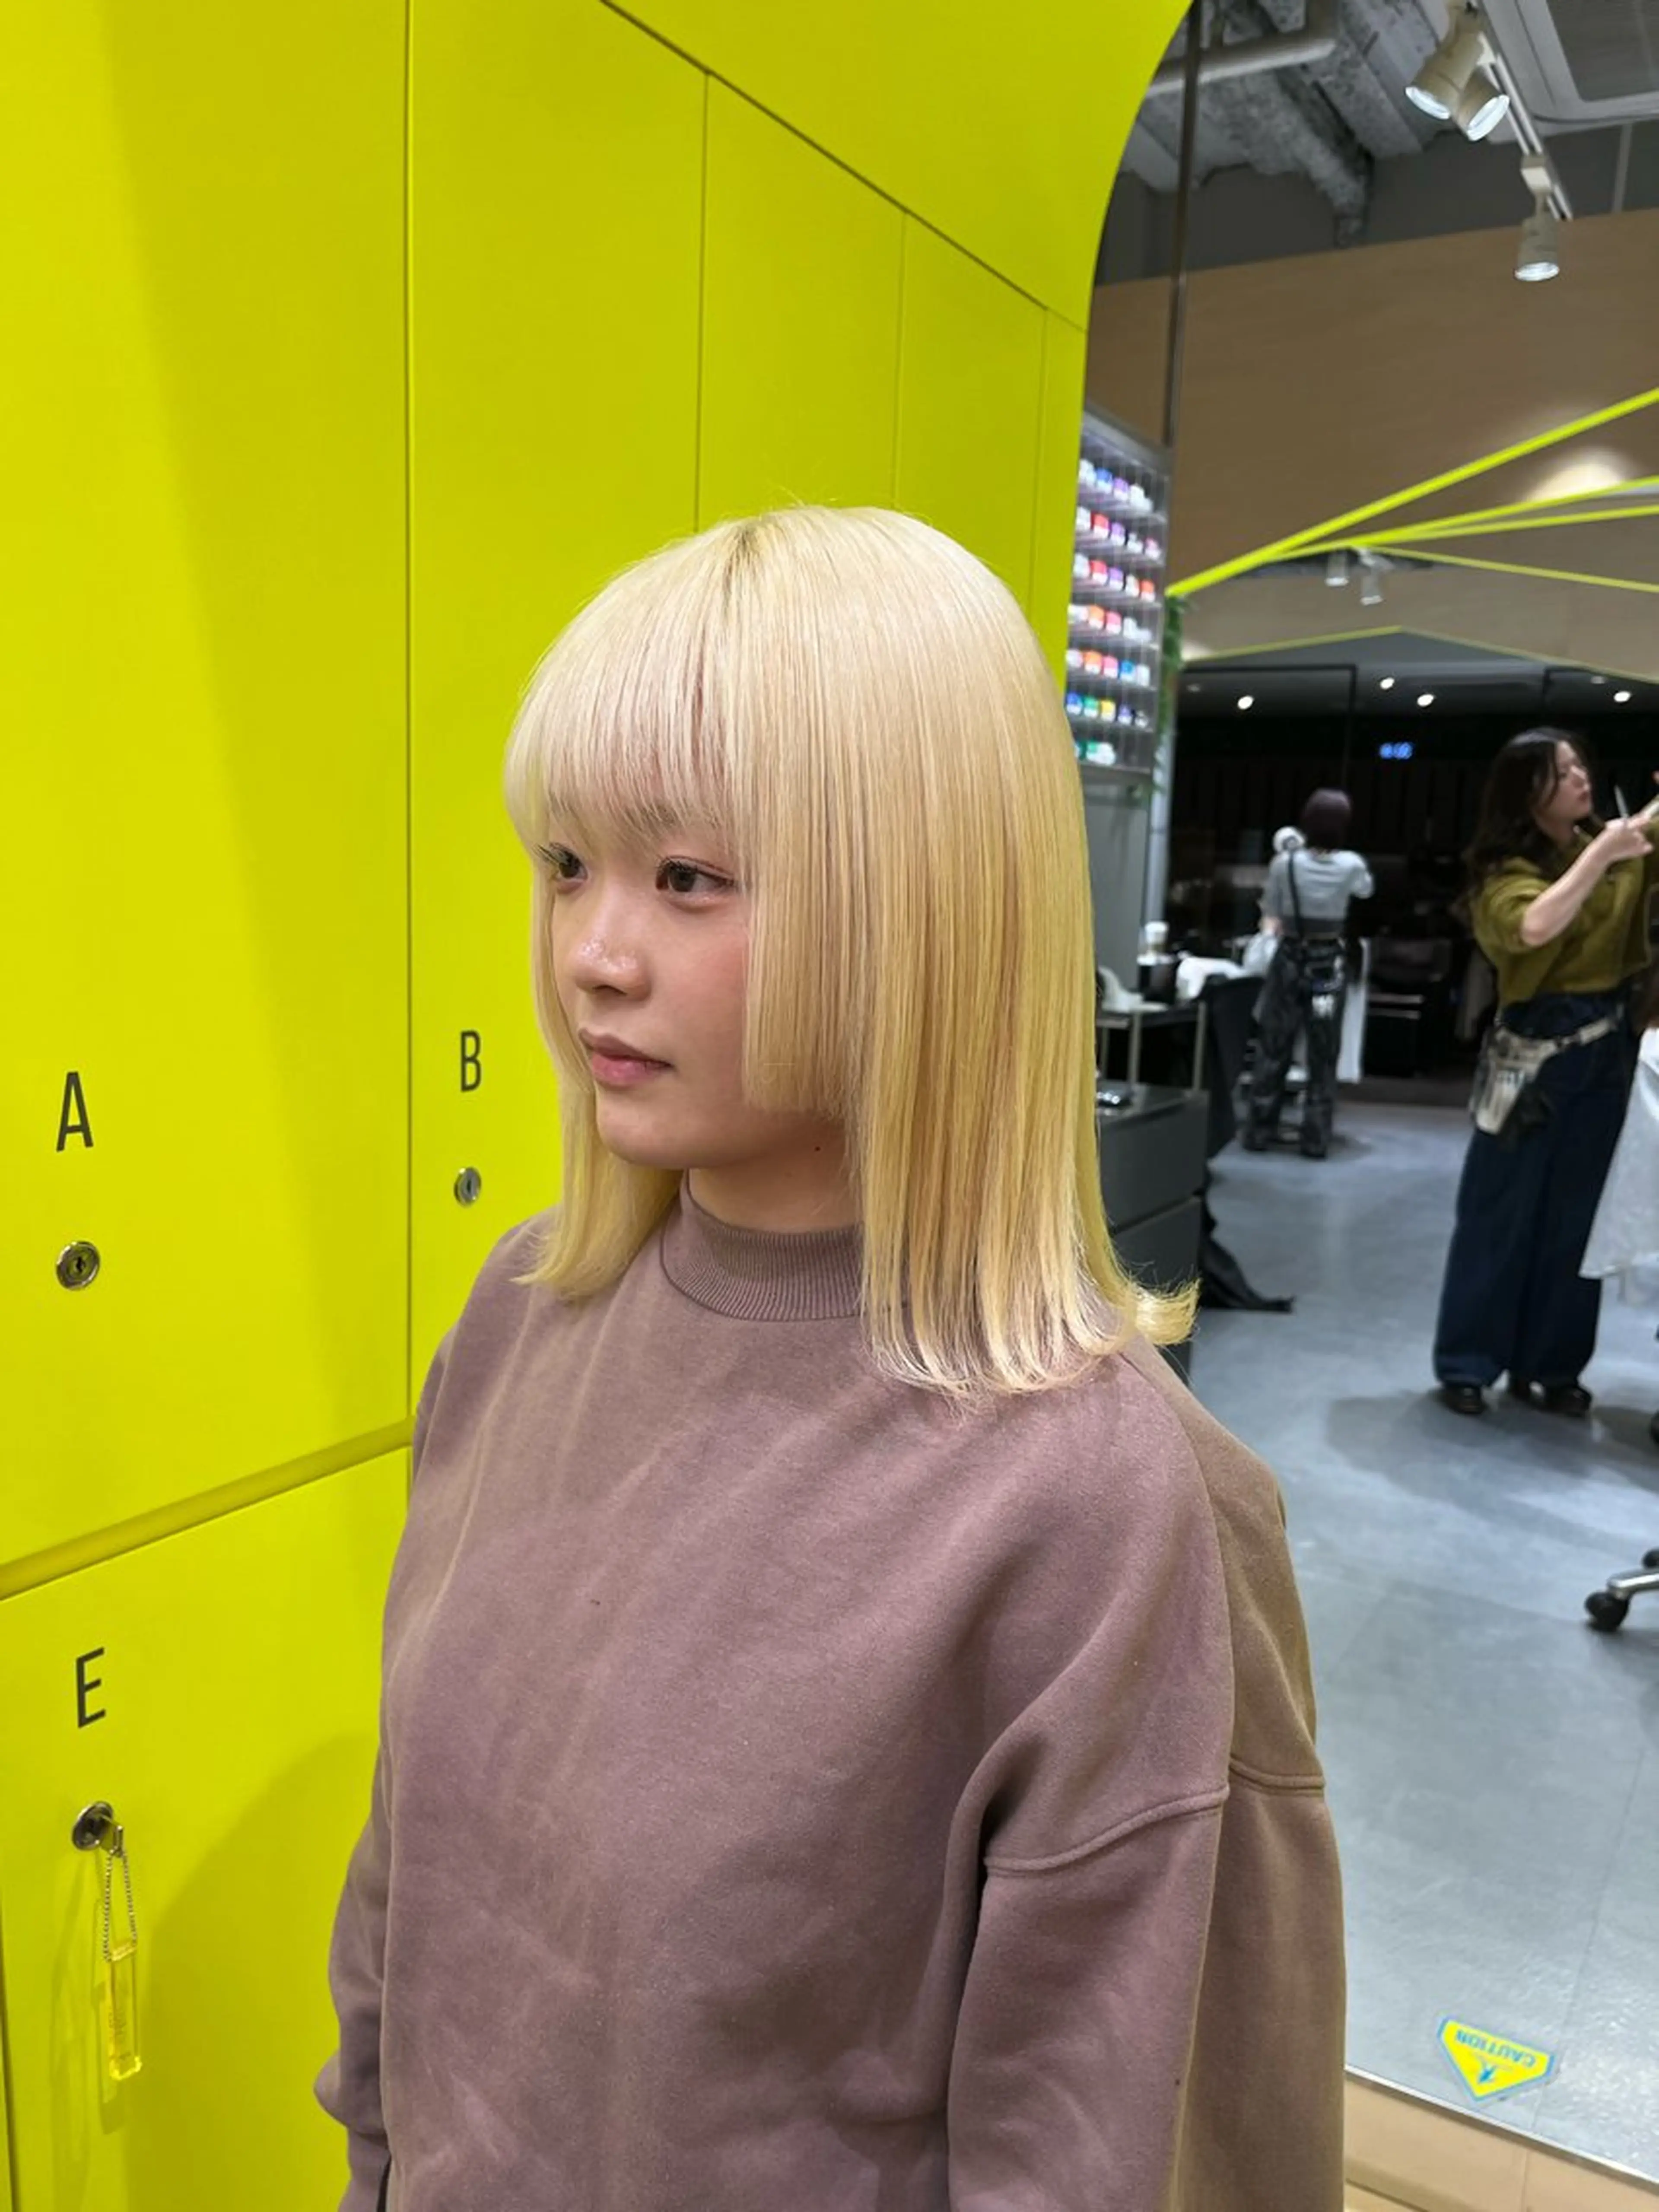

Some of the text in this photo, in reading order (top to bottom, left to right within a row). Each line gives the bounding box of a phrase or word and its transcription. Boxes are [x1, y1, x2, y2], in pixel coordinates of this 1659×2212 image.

[461, 1030, 481, 1092] B
[57, 1071, 93, 1151] A
[76, 1647, 105, 1728] E
[1457, 2030, 1535, 2067] CAUTION
